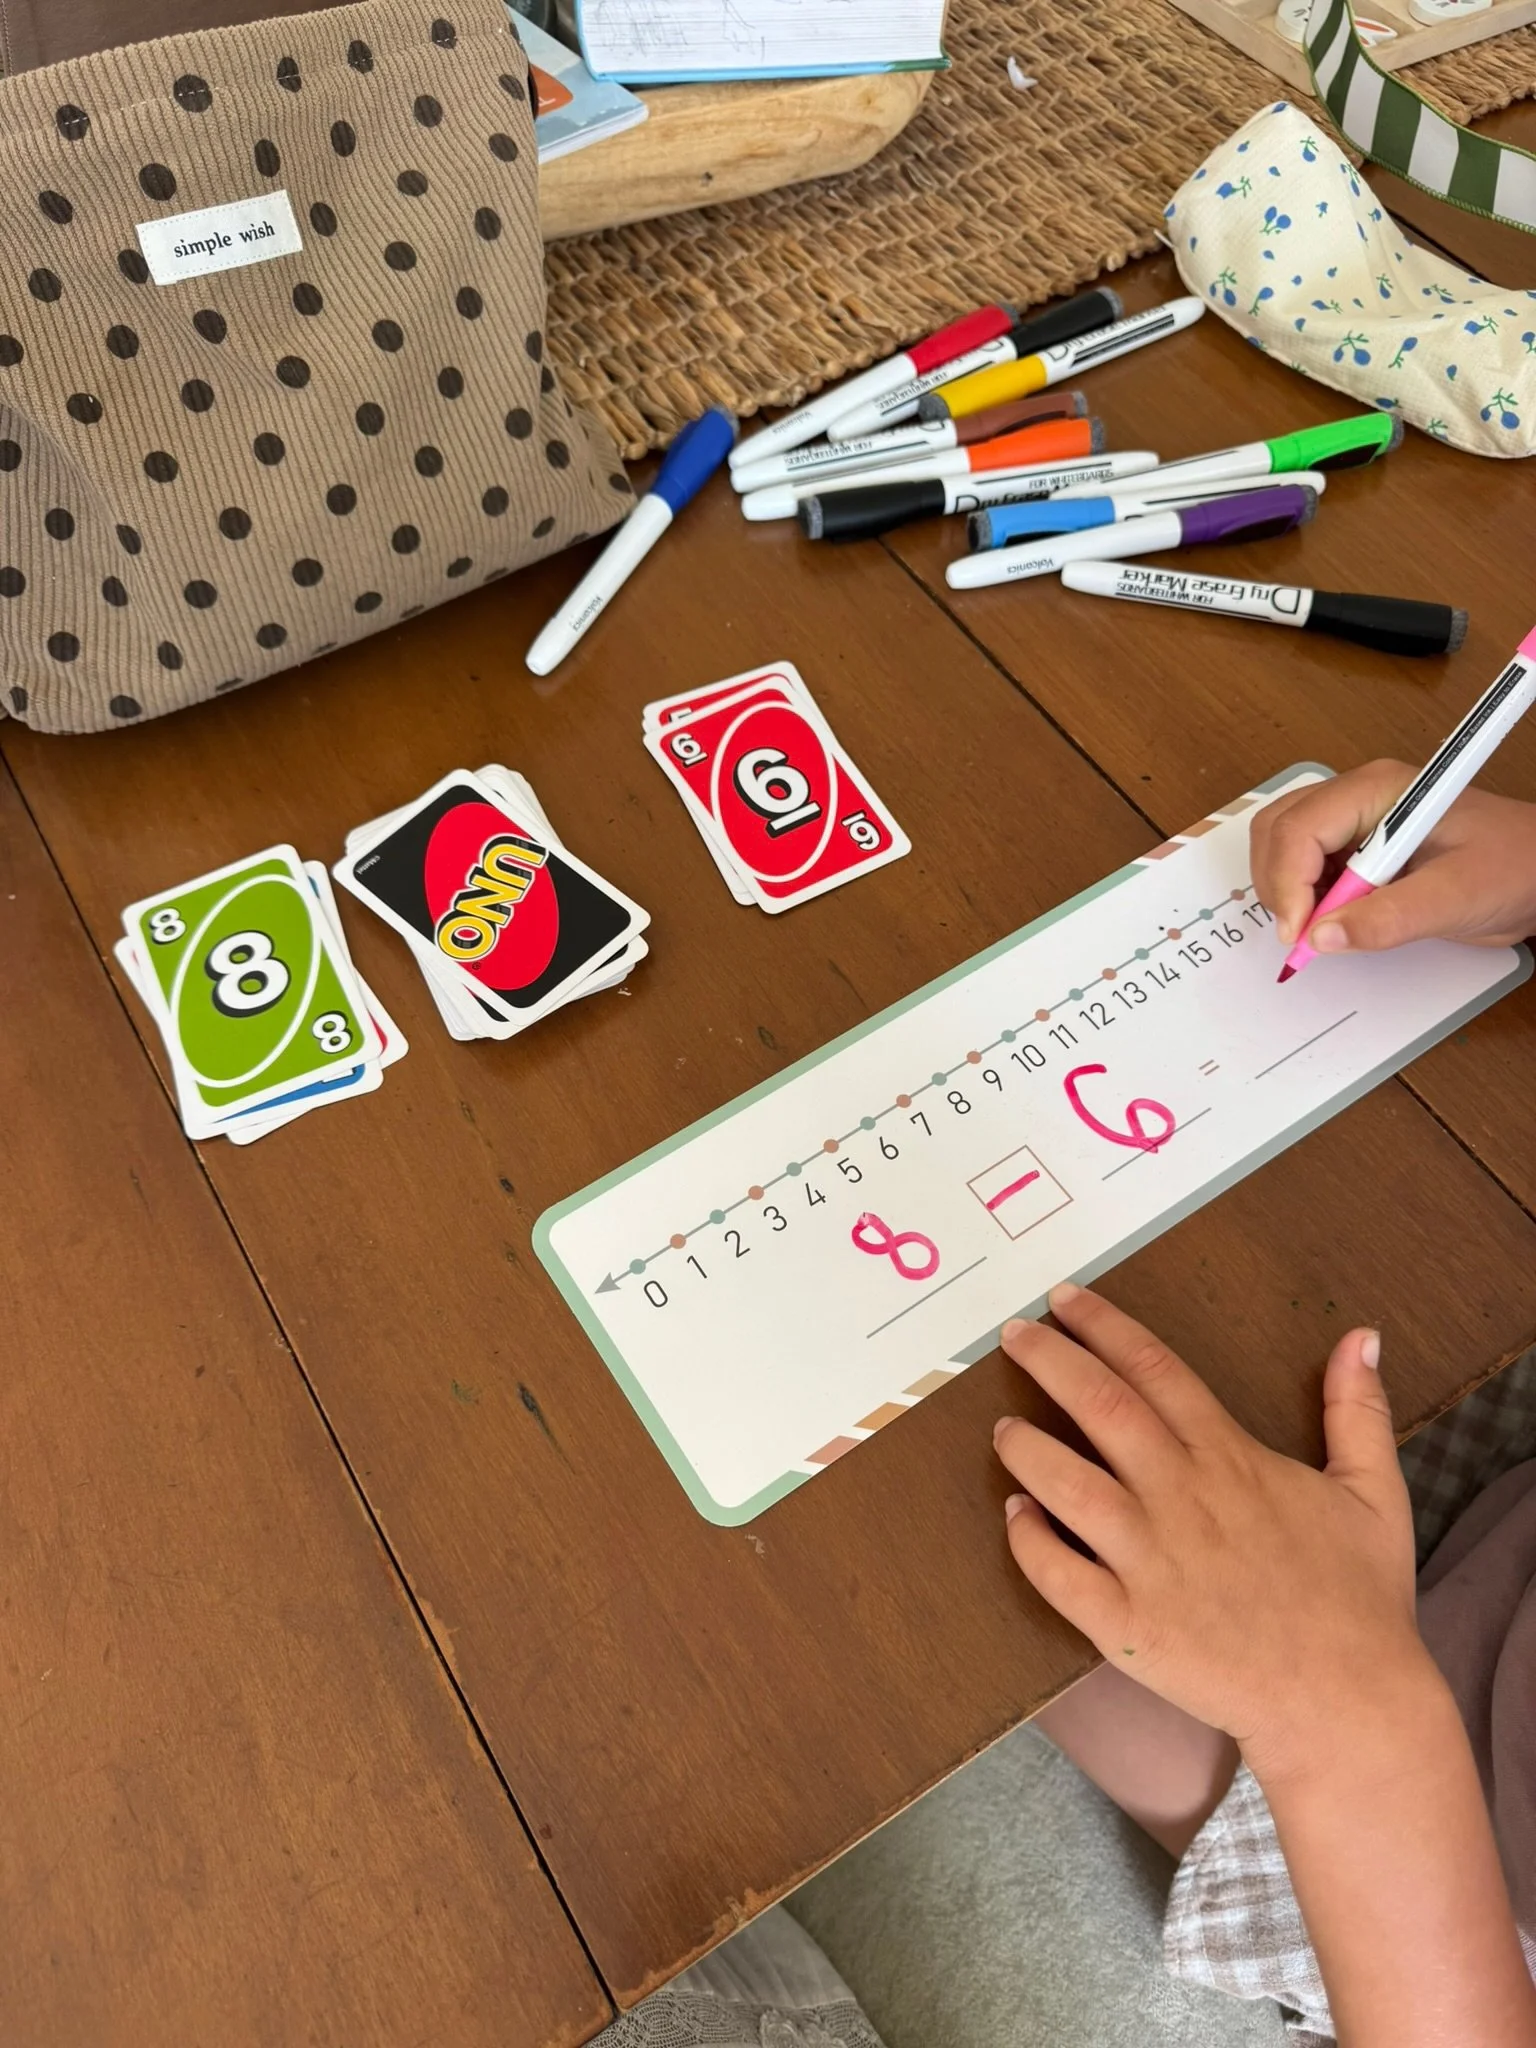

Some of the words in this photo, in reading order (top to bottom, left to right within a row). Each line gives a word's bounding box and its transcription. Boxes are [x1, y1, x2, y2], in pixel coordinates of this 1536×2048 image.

[173, 231, 233, 258] simple
[238, 220, 276, 244] wish
[1029, 476, 1048, 489] FOR
[1049, 469, 1114, 487] WHITEBOARDS
[1006, 557, 1054, 575] Volcanics
[1119, 568, 1187, 592] Marker
[1116, 581, 1190, 602] WHITEBOARDS
[1192, 578, 1245, 600] Erase
[1192, 592, 1213, 605] FOR
[1250, 584, 1301, 615] Dry
[671, 732, 708, 767] 6
[733, 746, 822, 839] 6
[841, 809, 882, 852] 6
[436, 834, 549, 961] UNO
[149, 907, 187, 945] 8
[204, 929, 291, 1018] 8
[312, 1010, 353, 1054] 8
[643, 1280, 669, 1308] 0
[686, 1255, 708, 1279] 1
[724, 1230, 751, 1258] 2
[763, 1206, 788, 1231] 3
[805, 1183, 827, 1206] 4
[837, 1157, 863, 1183] 5
[879, 1136, 900, 1160] 6
[910, 1111, 932, 1136] 7
[946, 1090, 972, 1115] 8
[982, 1068, 1004, 1092] 9
[1010, 1043, 1046, 1073] 10
[1048, 1024, 1079, 1049] 11
[1079, 1002, 1116, 1031] 12
[1112, 981, 1148, 1010] 13
[1144, 961, 1182, 989] 14
[1178, 940, 1213, 969] 15
[1210, 922, 1245, 948] 16
[1242, 901, 1273, 928] 17
[850, 1211, 941, 1281] 8
[1063, 1063, 1176, 1153] 6
